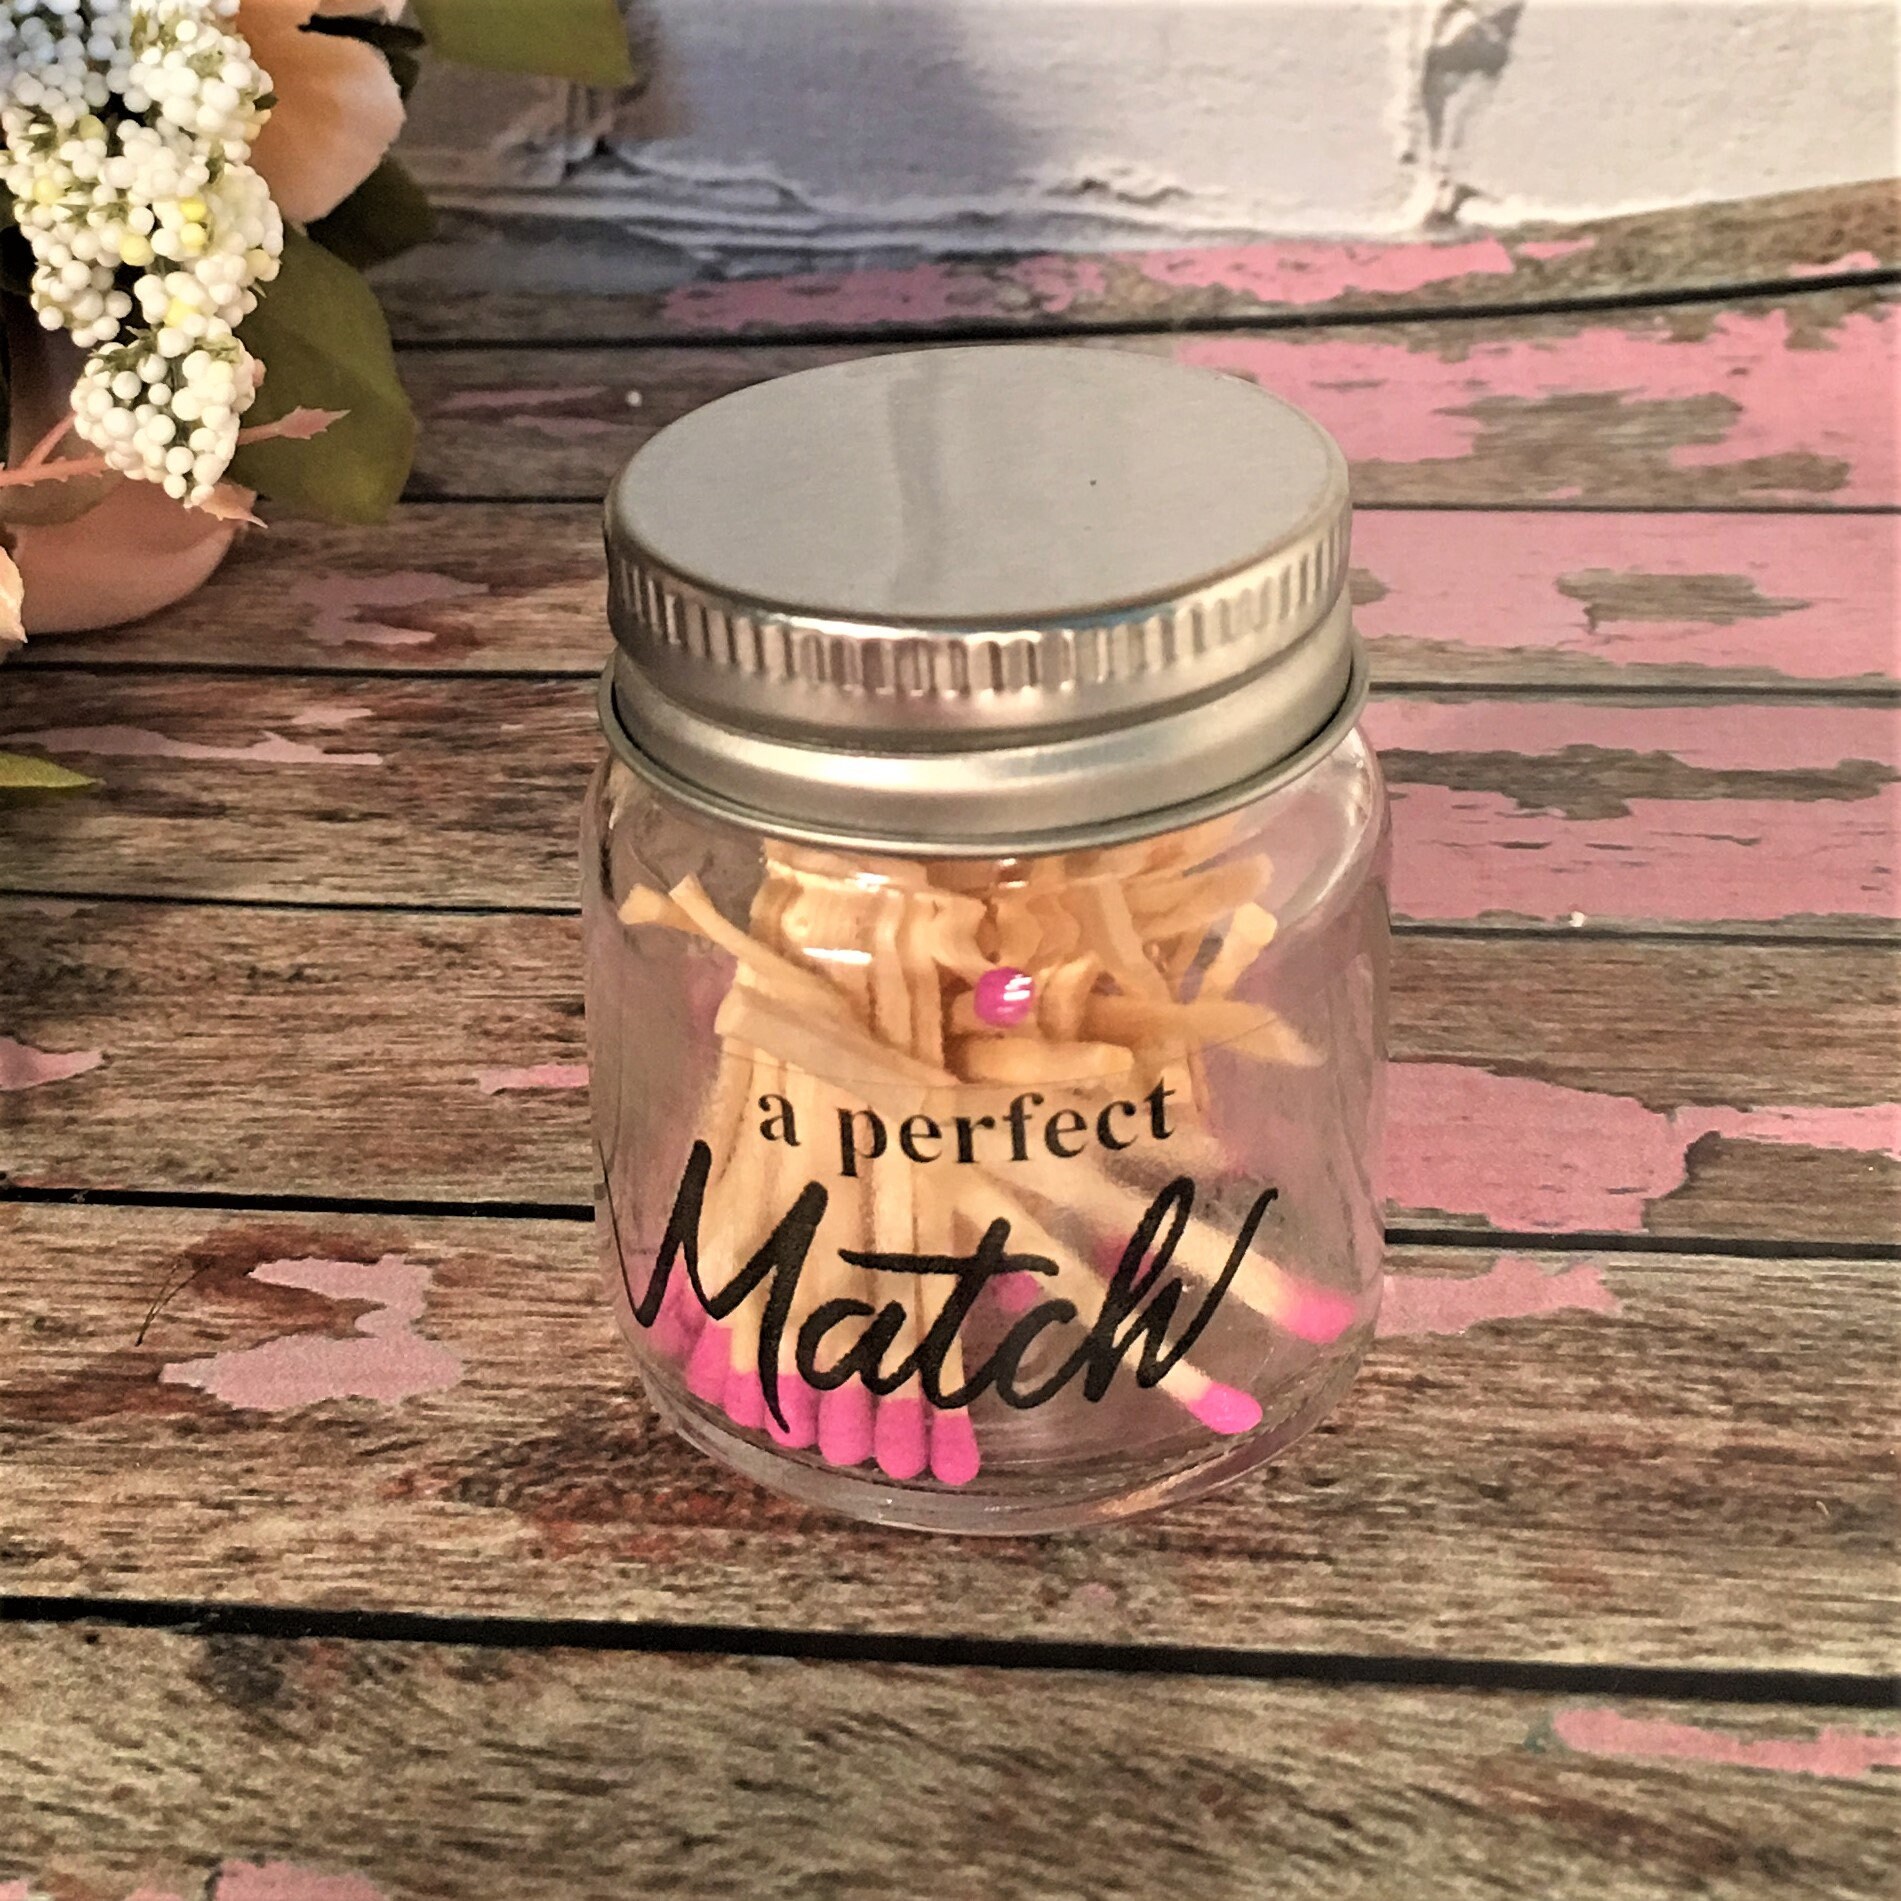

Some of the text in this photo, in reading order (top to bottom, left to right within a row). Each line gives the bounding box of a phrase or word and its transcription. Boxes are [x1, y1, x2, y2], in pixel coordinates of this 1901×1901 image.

[759, 1077, 1178, 1177] a perfect
[599, 1138, 1280, 1435] Match
